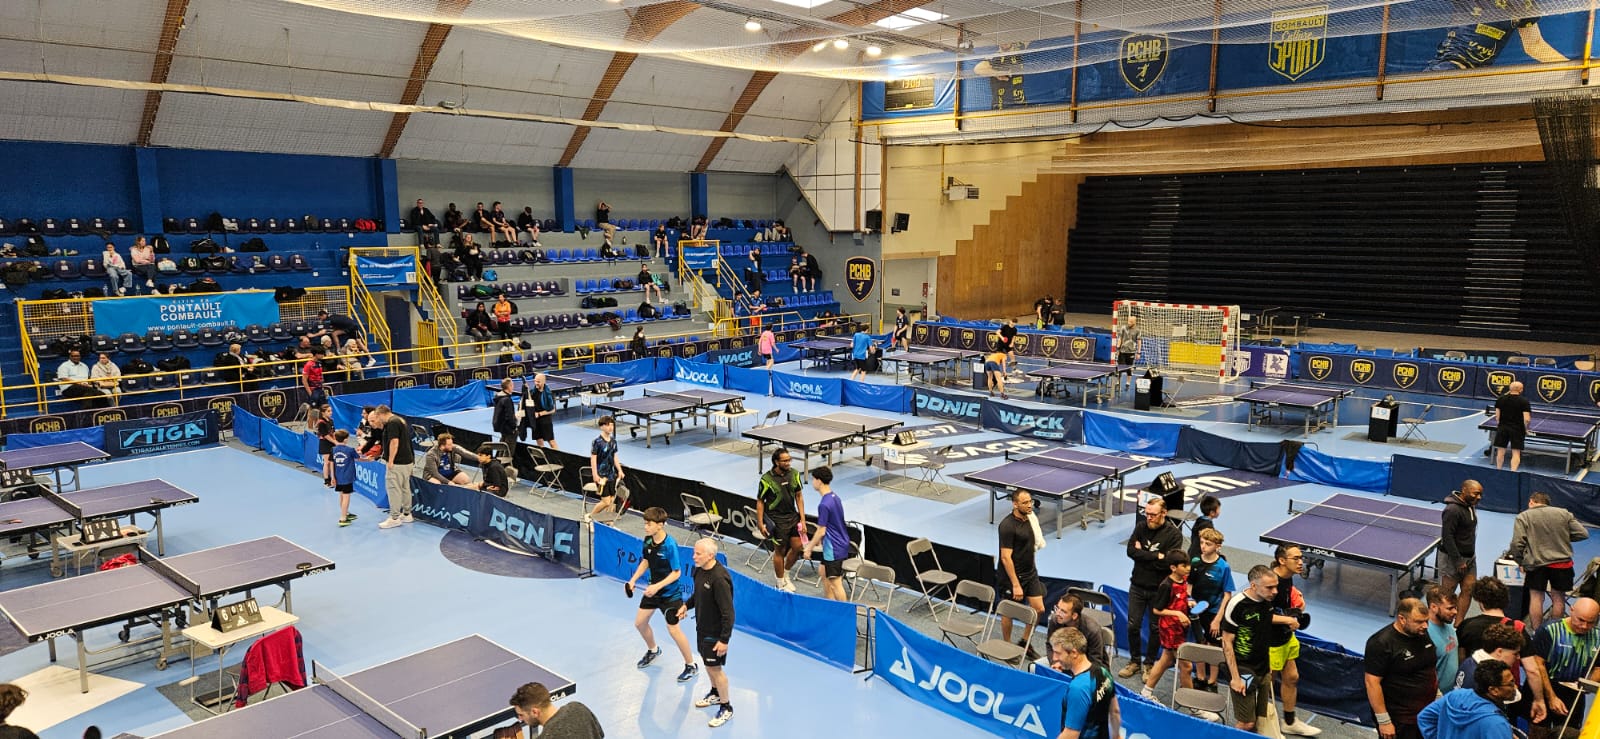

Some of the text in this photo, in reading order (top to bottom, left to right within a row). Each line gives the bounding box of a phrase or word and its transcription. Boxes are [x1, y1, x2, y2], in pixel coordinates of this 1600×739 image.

[1127, 39, 1162, 61] PCHB
[1272, 37, 1319, 75] SPORT
[849, 263, 872, 280] PCHB
[160, 302, 221, 313] PONTAULT
[160, 310, 222, 321] COMBAULT
[718, 350, 753, 364] WACK
[1312, 359, 1329, 370] PCHB
[1354, 362, 1371, 373] PCHB
[1397, 366, 1415, 377] PCHB
[686, 369, 719, 384] JOOLA
[1442, 370, 1461, 381] PCHB
[790, 381, 823, 395] JOOLA
[1541, 379, 1562, 391] PCHB
[1000, 410, 1064, 431] WACK
[123, 422, 205, 447] STIGA
[1311, 548, 1336, 558] JOOLA
[1503, 566, 1522, 580] 11
[221, 609, 229, 621] 6
[247, 601, 258, 614] 10
[44, 628, 75, 640] JOOLA
[917, 664, 1048, 738] JOOLA
